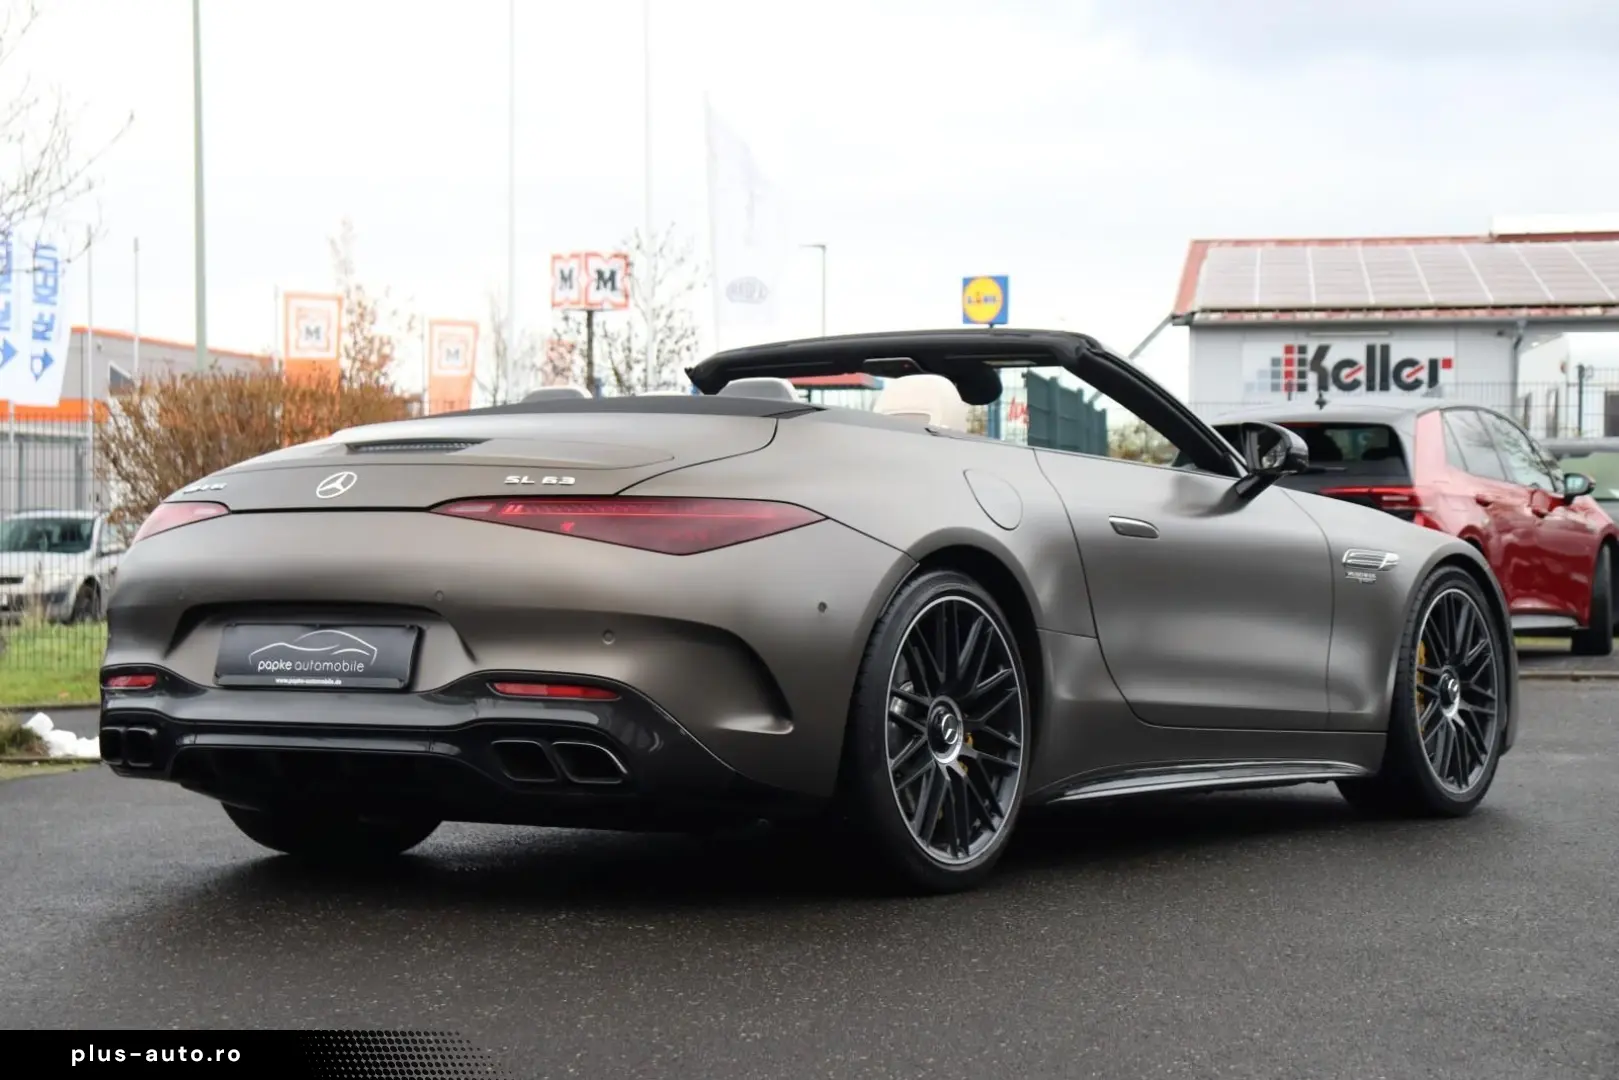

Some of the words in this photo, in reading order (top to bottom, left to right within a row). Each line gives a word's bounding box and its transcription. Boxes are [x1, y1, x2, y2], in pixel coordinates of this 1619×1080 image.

[559, 267, 574, 290] M
[595, 268, 617, 291] M
[305, 326, 321, 341] M
[1297, 343, 1453, 392] Keller
[504, 475, 535, 485] SL
[542, 476, 576, 486] 63
[257, 659, 293, 672] papke
[294, 660, 365, 673] automobile
